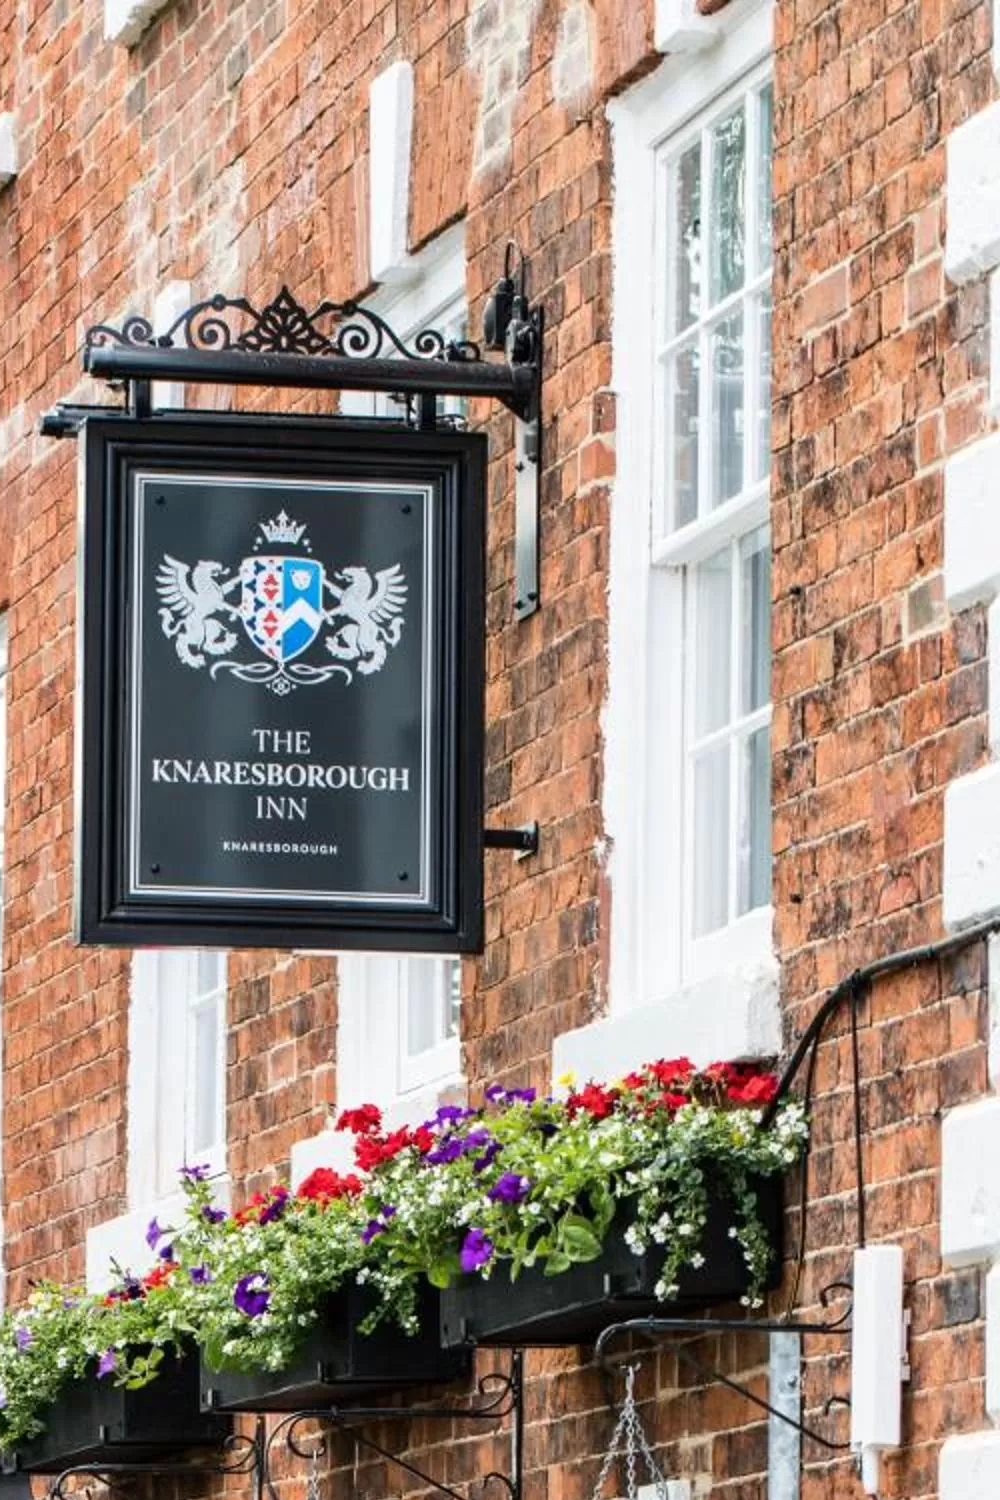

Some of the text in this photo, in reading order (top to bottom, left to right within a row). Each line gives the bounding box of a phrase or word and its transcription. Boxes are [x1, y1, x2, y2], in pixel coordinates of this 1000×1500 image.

[251, 729, 312, 754] THE
[151, 758, 410, 791] KNARESBOROUGH
[255, 795, 308, 820] INN
[223, 840, 338, 854] KNARESBOROUGH
